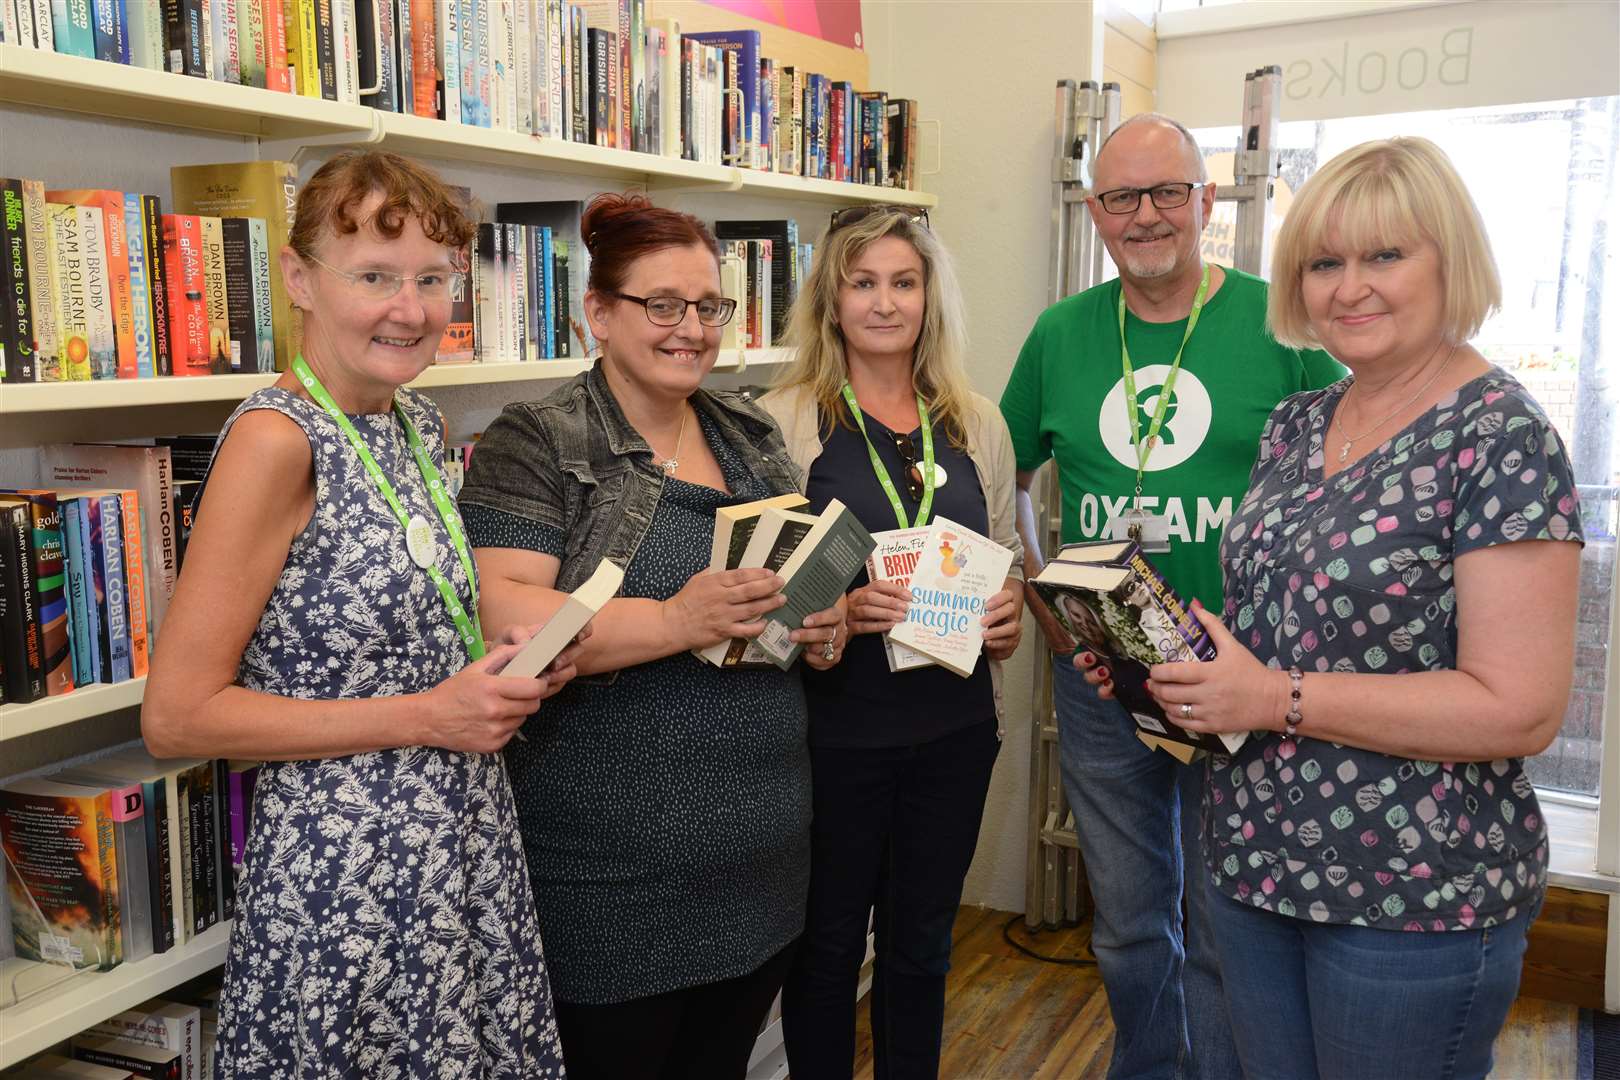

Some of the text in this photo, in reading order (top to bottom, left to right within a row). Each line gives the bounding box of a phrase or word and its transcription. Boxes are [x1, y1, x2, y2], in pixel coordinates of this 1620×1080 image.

[190, 9, 201, 66] JEFFERSON BASS
[228, 28, 240, 74] SECRET
[254, 31, 264, 65] STONE
[323, 28, 331, 57] GIRLS
[507, 21, 515, 70] GERRITSEN
[550, 22, 561, 106] GODDARD
[597, 40, 607, 94] GRISHAM
[608, 45, 617, 97] GRISHAM
[621, 67, 631, 129] RUNAWAY JURY
[4, 190, 18, 231] BONNER
[16, 199, 25, 224] HILARY
[283, 183, 297, 224] DAN
[30, 197, 52, 312] SAM BOURNE
[109, 214, 121, 257] BROCKMANN
[151, 224, 159, 248] Bodies
[180, 238, 193, 286] BROWN
[12, 236, 29, 336] friends to die for
[55, 217, 74, 331] THE LAST TESTAMENT
[64, 218, 87, 332] SAM BOURNE
[84, 224, 104, 312] TOM BRADBY
[153, 258, 161, 280] Buried
[190, 249, 199, 277] DAN
[210, 243, 225, 320] DAN BROWN
[259, 251, 272, 327] DAN BROWN
[118, 274, 131, 334] Over the Edge
[133, 282, 151, 363] HERON
[155, 284, 168, 355] BROOKMYRE
[188, 314, 197, 345] CODE
[206, 304, 214, 326] CODE
[36, 512, 62, 530] gold
[102, 499, 118, 572] HARLAN
[125, 496, 139, 569] HARLAN
[158, 458, 174, 570] Harlan COBEN
[1080, 492, 1233, 543] OXFAM
[17, 525, 33, 622] MARY HIGGINS CLARK
[73, 572, 84, 598] Spy
[1130, 554, 1203, 640] MICHAEL CONNELLY
[109, 578, 125, 640] COBEN
[131, 573, 144, 634] COBEN
[904, 606, 969, 637] magic
[910, 586, 989, 617] summer
[125, 793, 142, 815] D
[161, 819, 174, 908] PAULA DALY
[193, 846, 203, 880] Captain
